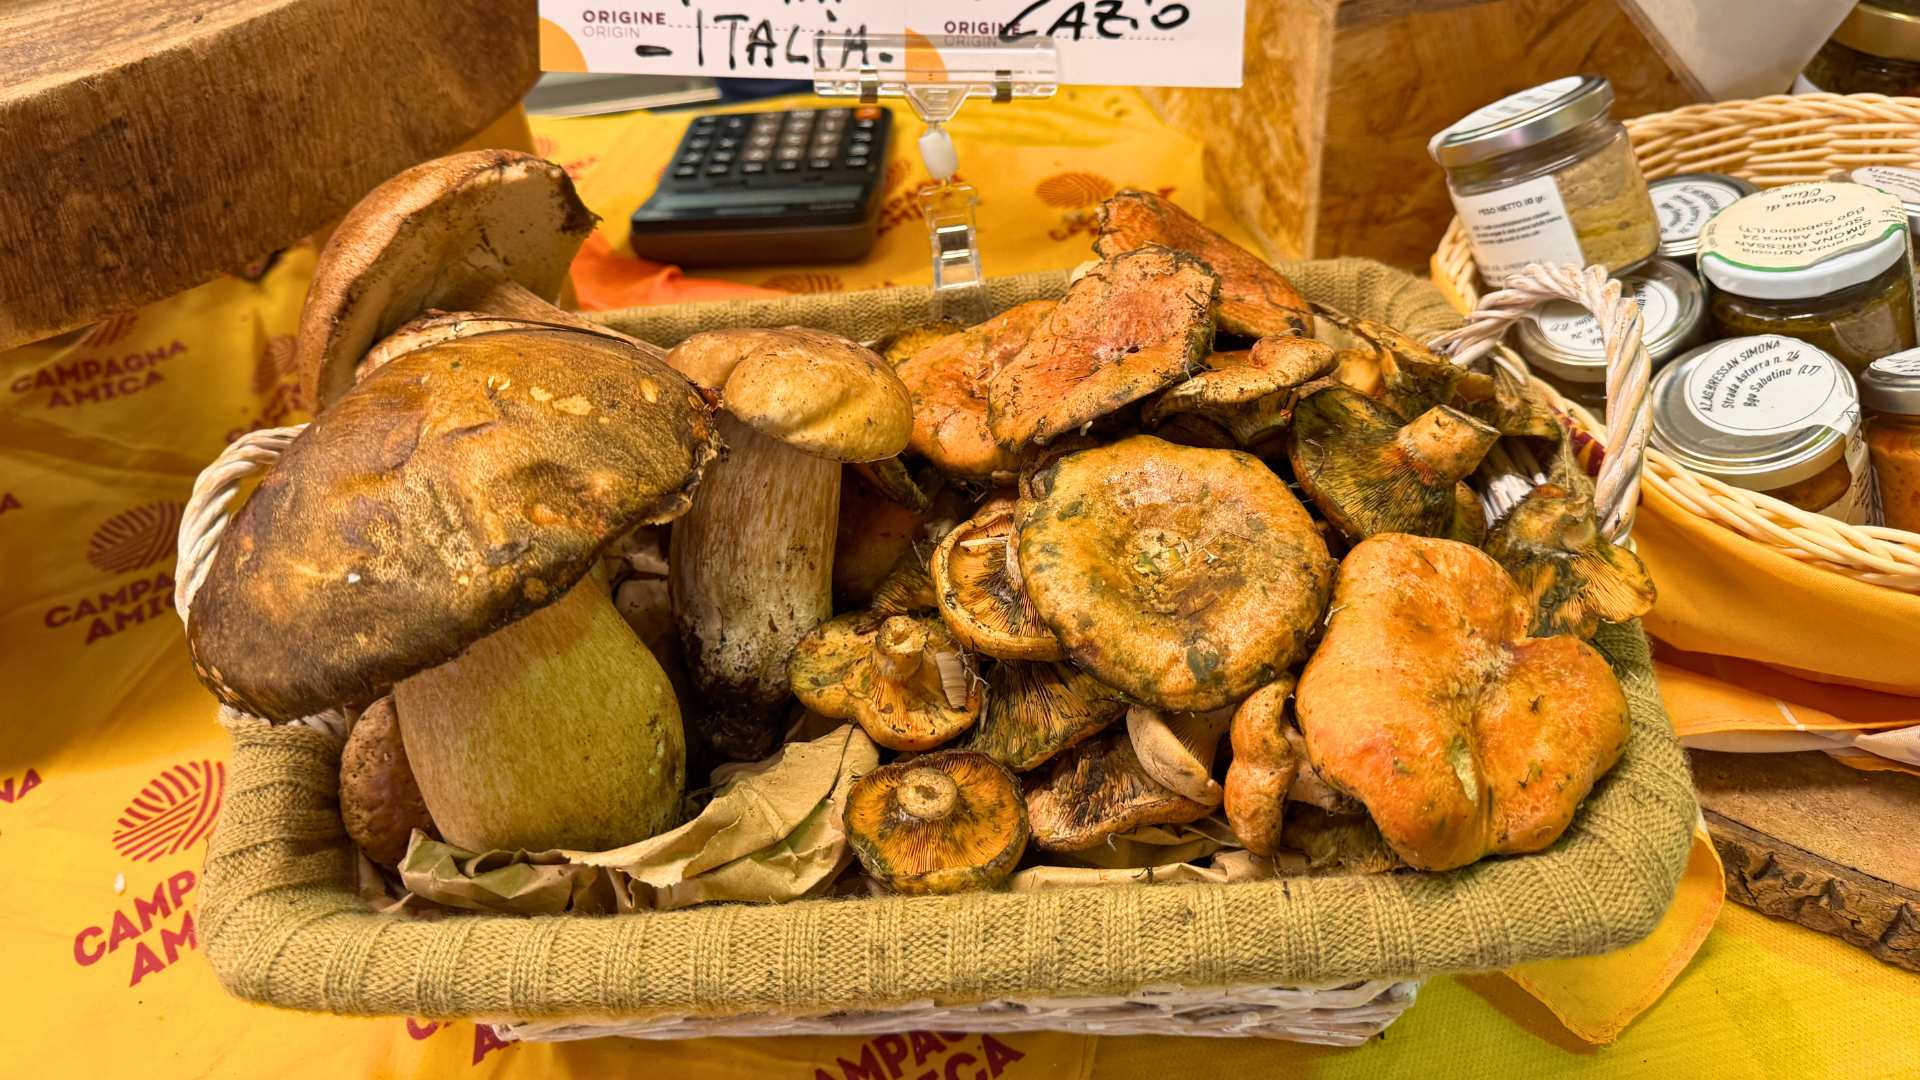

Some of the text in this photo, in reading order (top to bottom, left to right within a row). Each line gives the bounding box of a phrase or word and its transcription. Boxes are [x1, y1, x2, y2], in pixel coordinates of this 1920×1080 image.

[582, 9, 666, 25] ORIGINE
[582, 25, 641, 40] ORIGIN
[1735, 219, 1872, 250] SIMONA BRESSAN
[10, 340, 187, 394] CAMPAGNA
[1739, 339, 1781, 362] SIMONA
[48, 370, 164, 410] AMICA
[1721, 383, 1740, 409] Strada
[45, 572, 176, 628] CAMPA
[85, 591, 176, 645] AMI
[73, 870, 196, 967] CAMP
